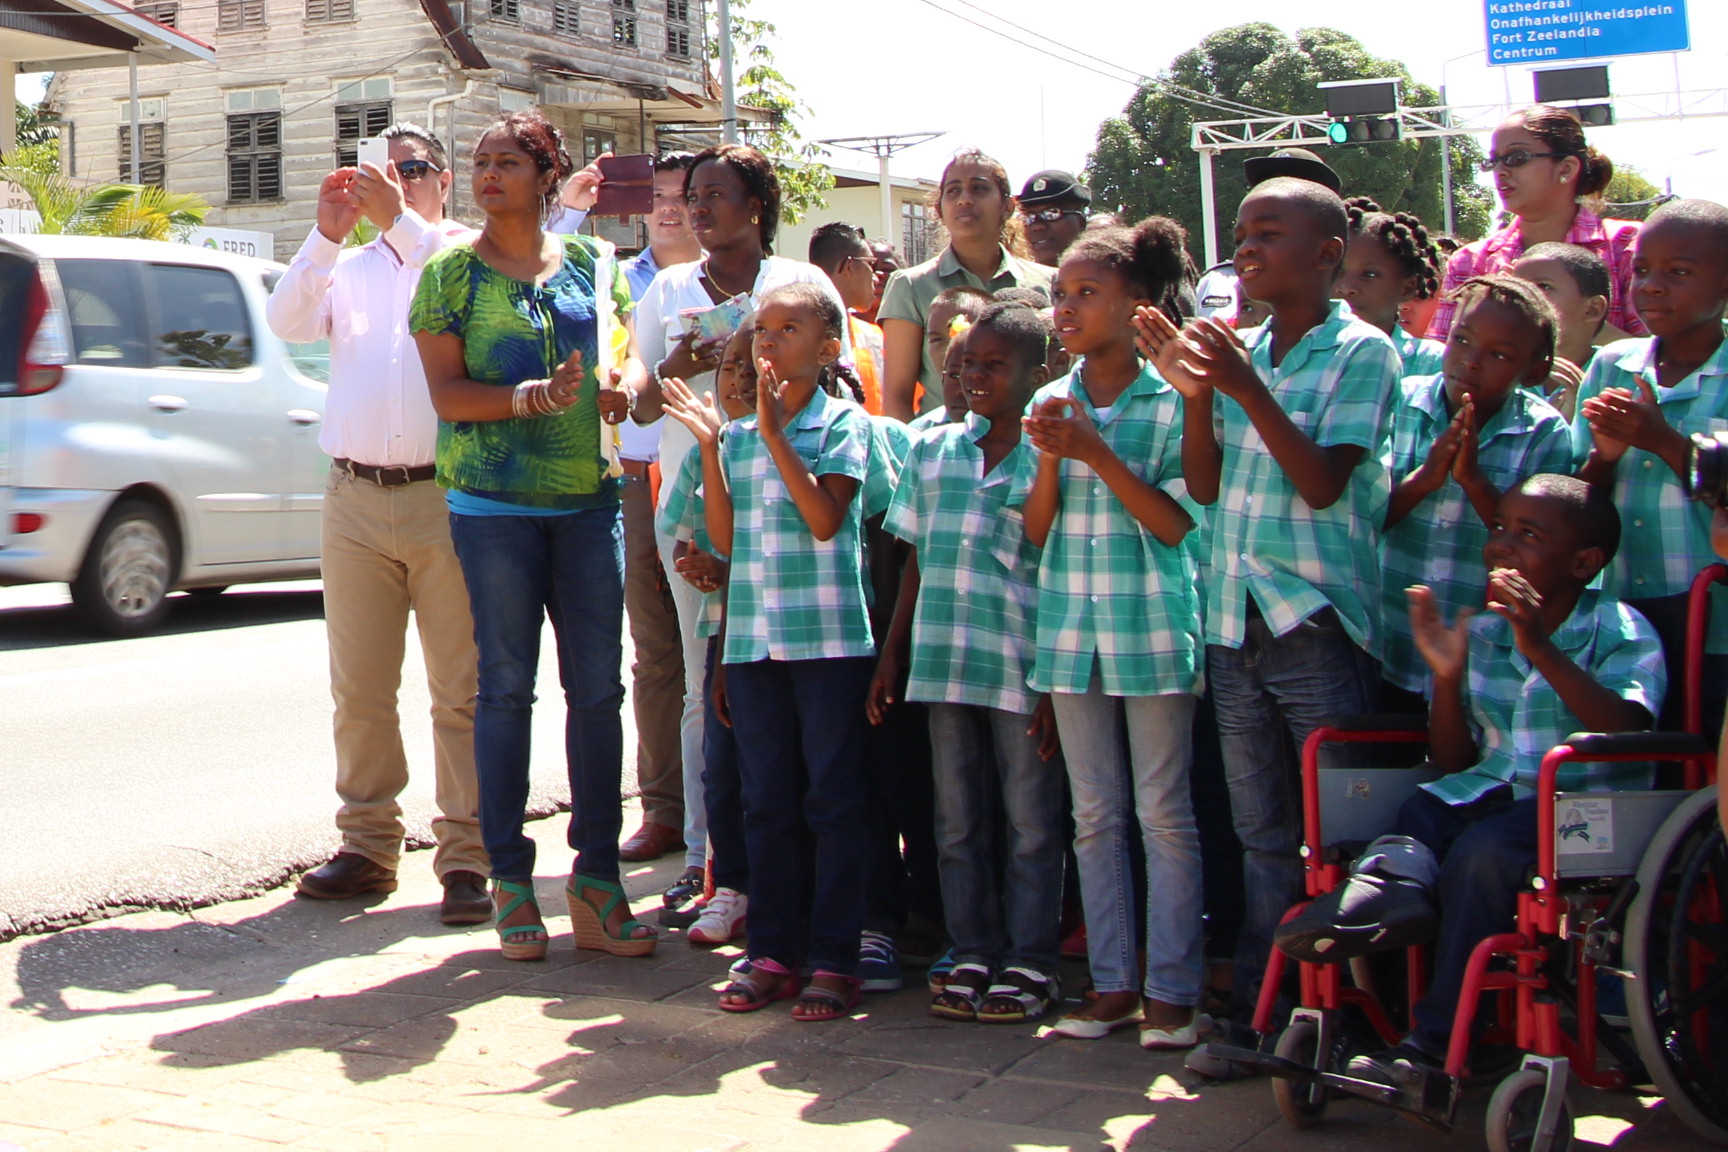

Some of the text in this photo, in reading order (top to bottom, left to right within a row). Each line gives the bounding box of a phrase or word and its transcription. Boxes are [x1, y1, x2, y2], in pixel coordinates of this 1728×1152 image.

[1490, 5, 1673, 30] Onafhankelijkheidsplein
[1492, 26, 1601, 45] Fort Zeelandia
[1493, 45, 1558, 60] Centrum
